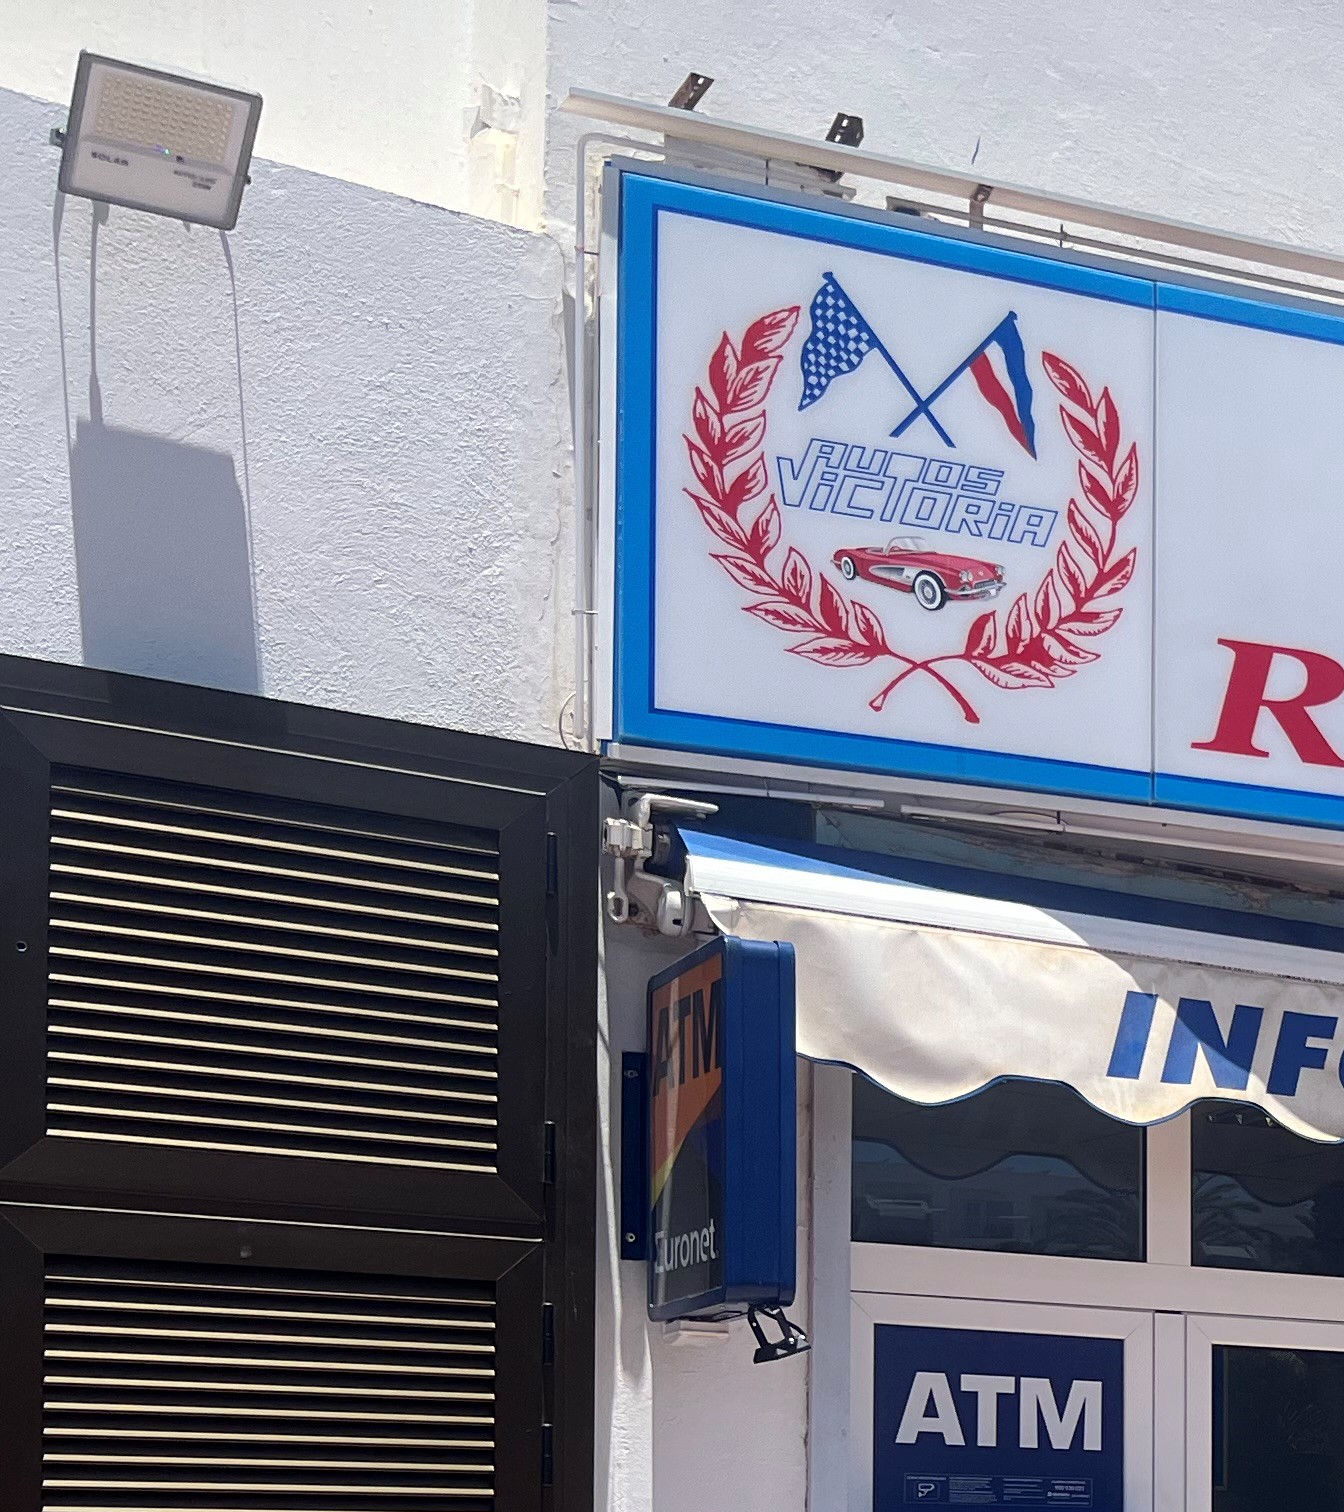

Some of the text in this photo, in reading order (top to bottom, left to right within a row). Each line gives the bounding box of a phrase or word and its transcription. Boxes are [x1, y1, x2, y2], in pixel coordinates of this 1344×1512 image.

[806, 438, 1005, 496] AUTOS
[653, 977, 723, 1098] ATM
[895, 1371, 1103, 1451] ATM
